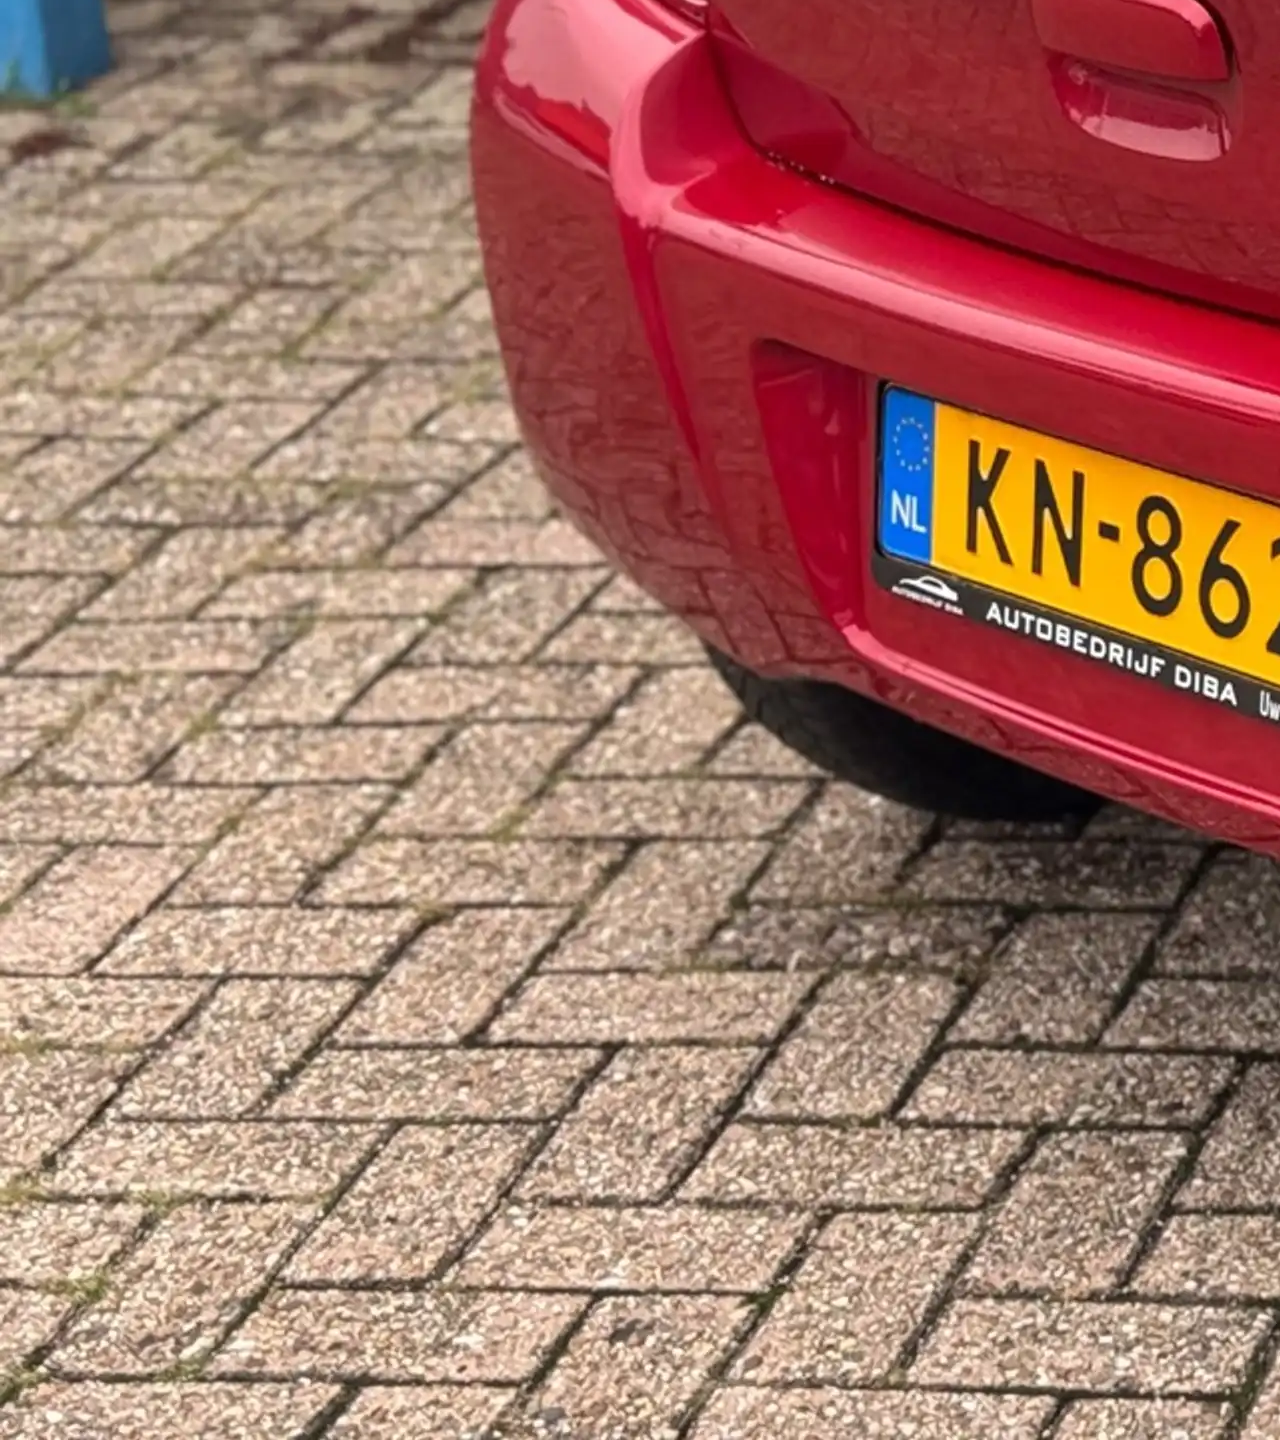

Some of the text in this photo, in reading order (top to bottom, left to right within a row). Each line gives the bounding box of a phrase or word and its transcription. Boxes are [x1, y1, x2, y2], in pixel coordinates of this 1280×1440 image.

[891, 490, 927, 535] NL
[986, 602, 1238, 707] AUTOBEDRIJF DIBA
[1259, 690, 1280, 721] Uw
